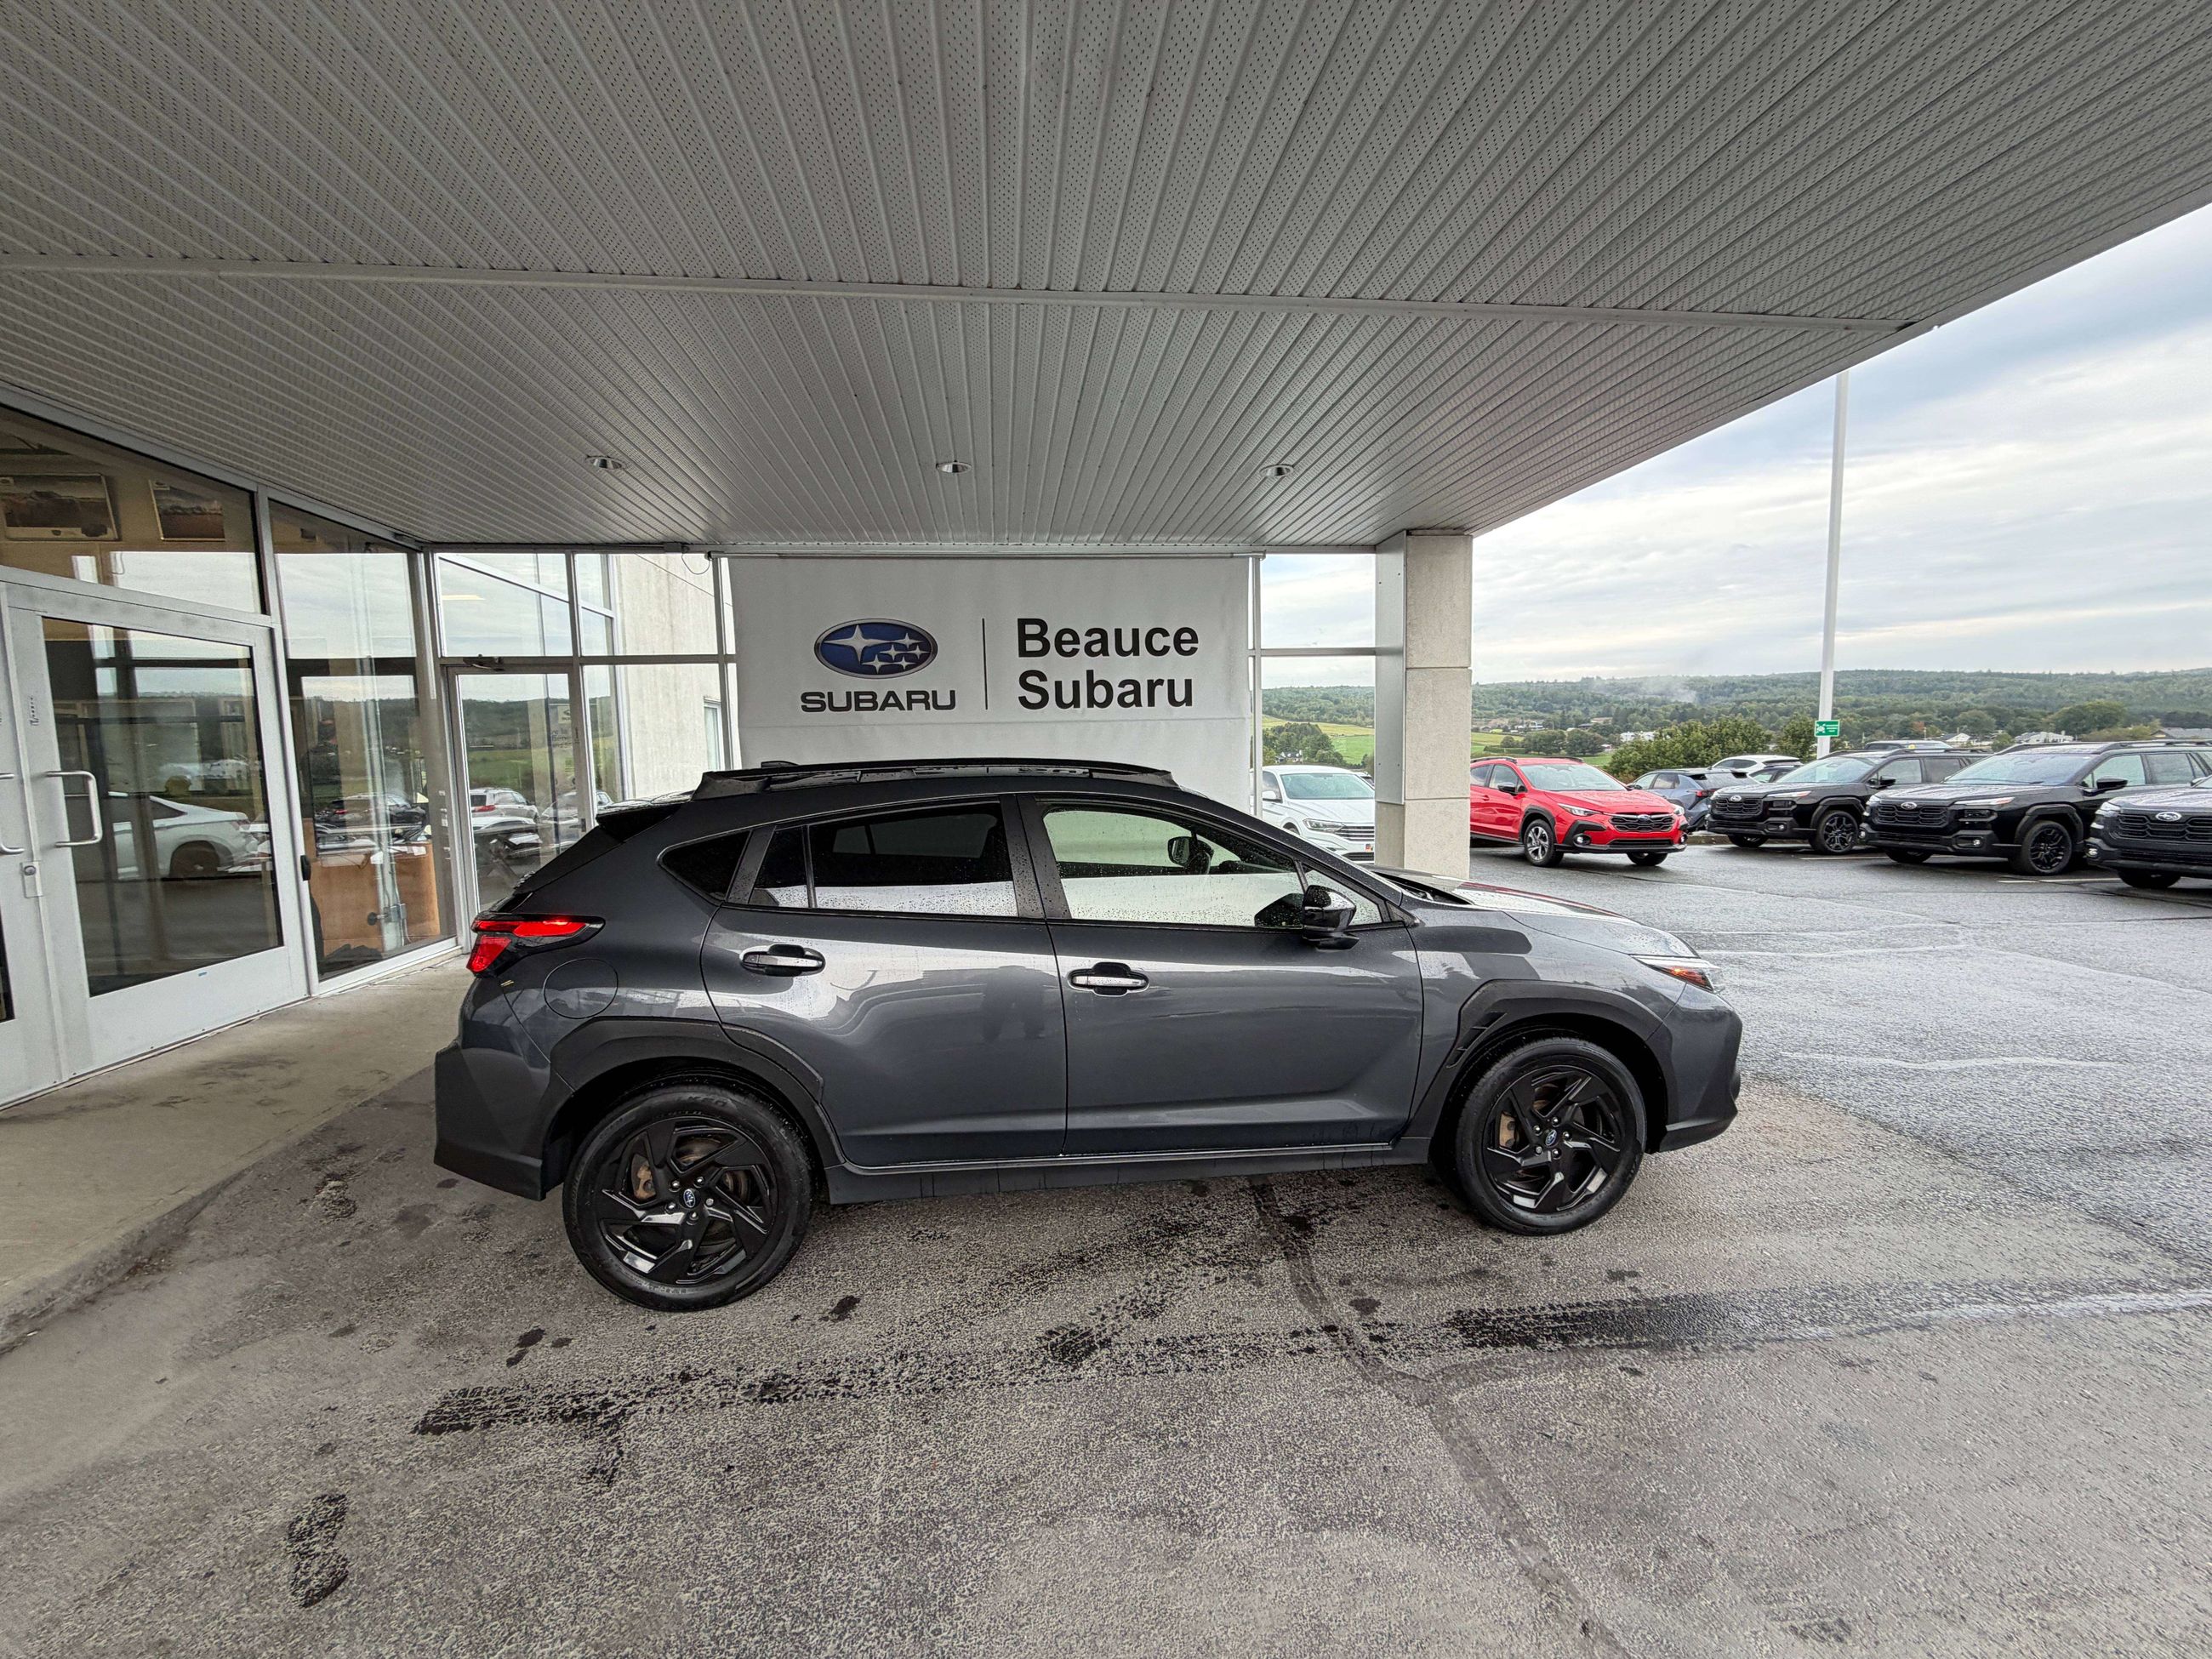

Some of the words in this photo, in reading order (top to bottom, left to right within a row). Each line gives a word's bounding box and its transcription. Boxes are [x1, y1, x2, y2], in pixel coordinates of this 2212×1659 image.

[1017, 618, 1199, 658] Beauce
[801, 689, 956, 713] SUBARU
[1018, 669, 1193, 710] Subaru
